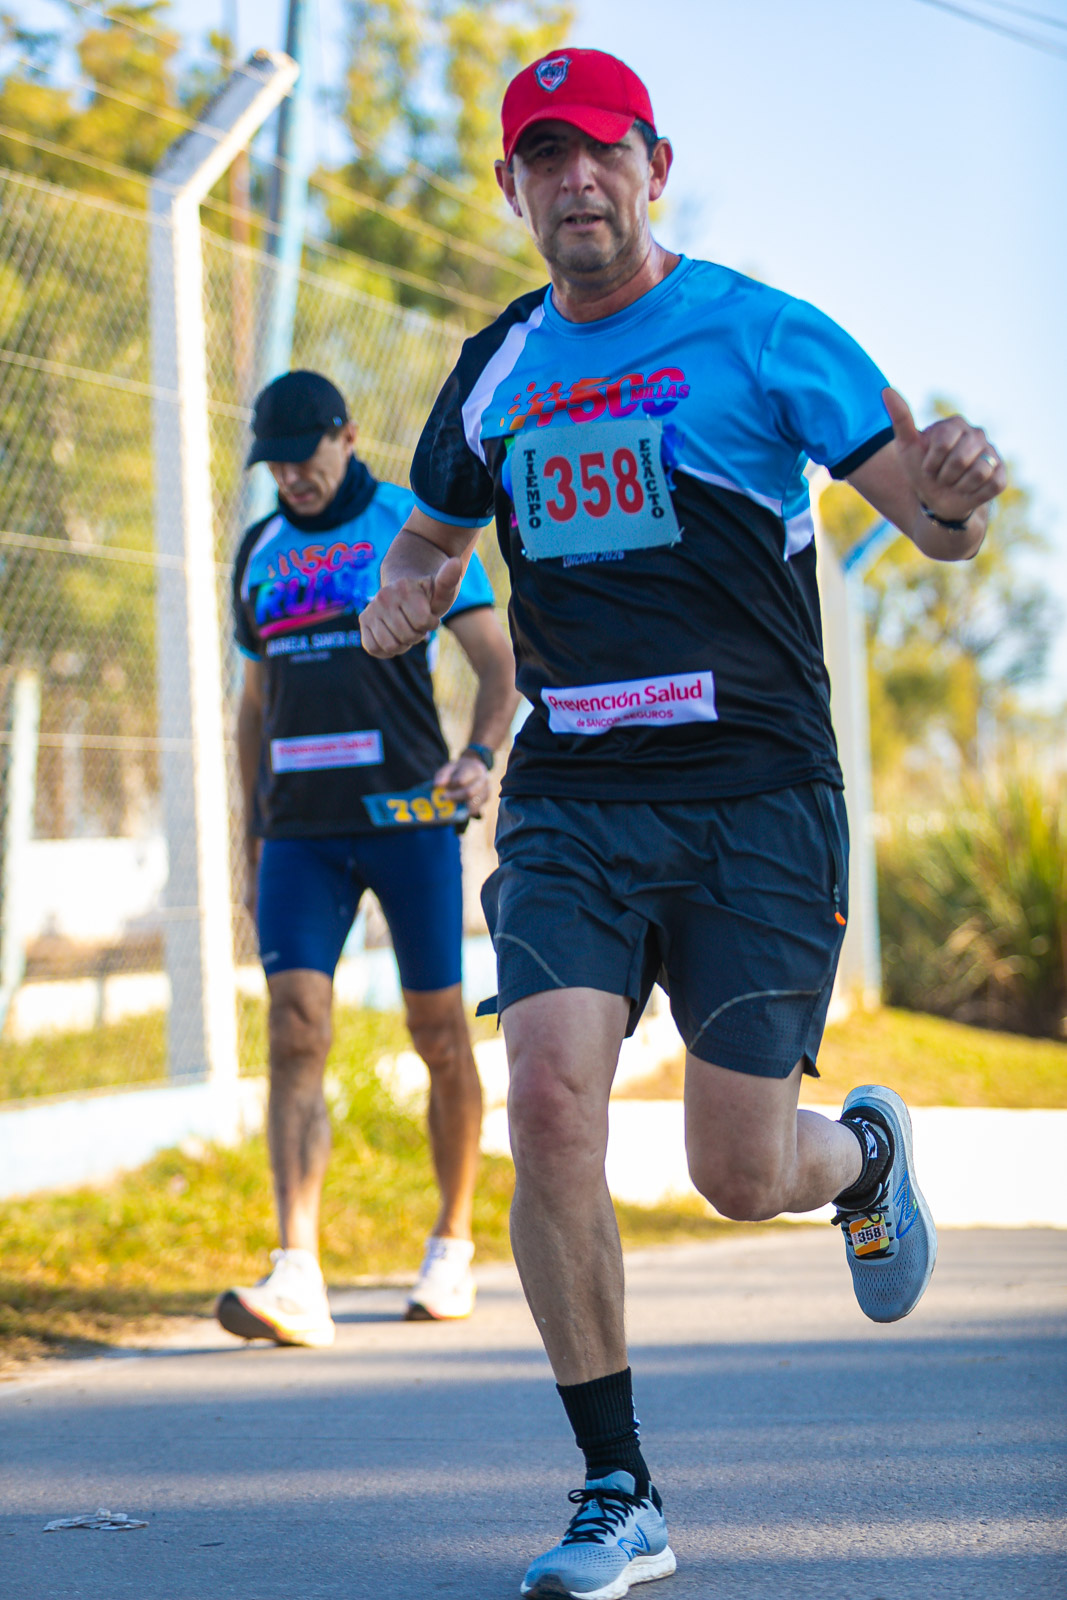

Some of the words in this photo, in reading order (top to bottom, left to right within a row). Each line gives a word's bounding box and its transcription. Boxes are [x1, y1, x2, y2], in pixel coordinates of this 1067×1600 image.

[630, 384, 690, 401] MILLAS
[523, 449, 542, 530] TIEMPO
[543, 447, 645, 523] 358
[638, 438, 665, 520] EXACTO
[548, 691, 641, 712] Prevención
[644, 679, 703, 705] Salud
[858, 1226, 882, 1243] 358
